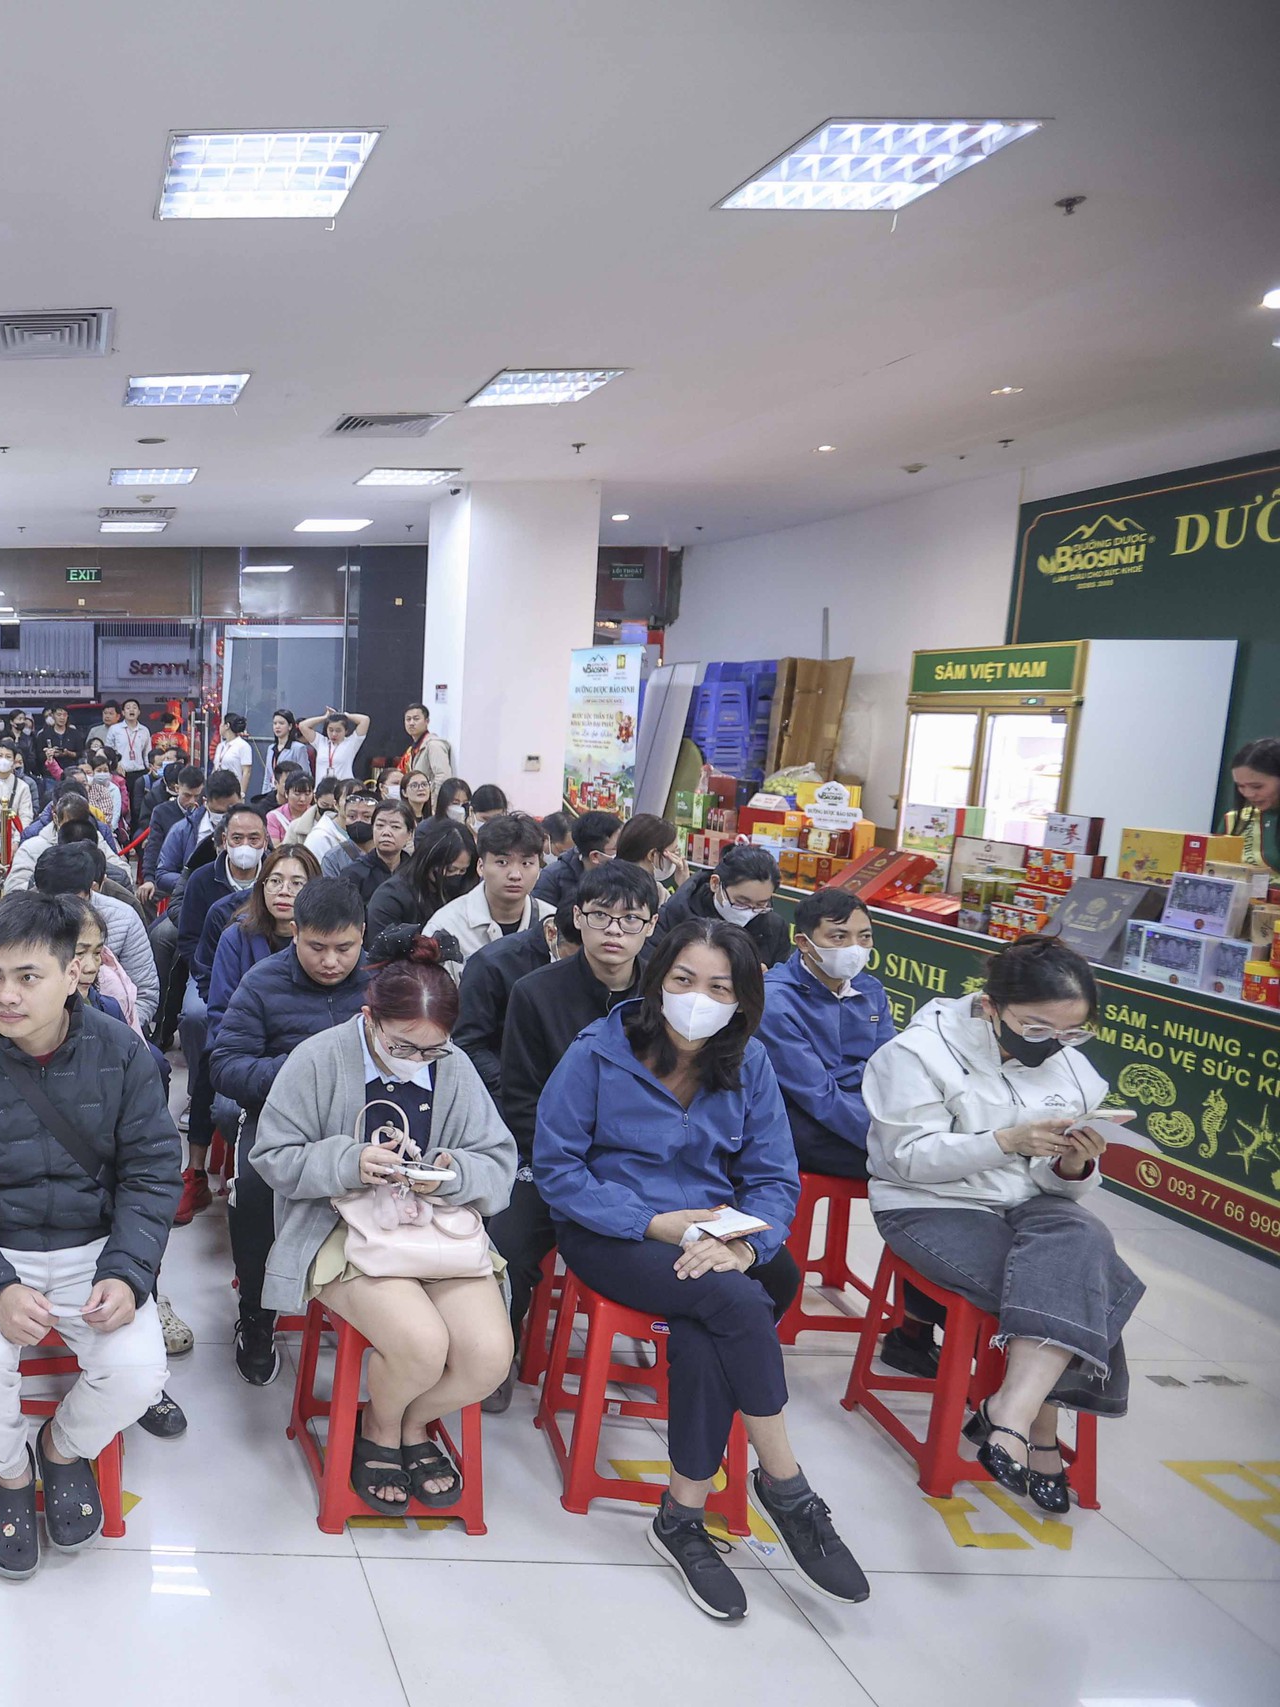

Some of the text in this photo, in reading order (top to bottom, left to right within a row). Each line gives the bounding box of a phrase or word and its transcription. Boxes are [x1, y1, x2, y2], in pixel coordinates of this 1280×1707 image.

[70, 569, 97, 580] EXIT
[935, 660, 1046, 684] SÂM VIỆT NAM
[885, 951, 948, 993] SINH
[1104, 1004, 1148, 1030] SÂM
[1163, 1020, 1242, 1058] NHUNG
[1121, 1033, 1165, 1059] BẢO
[1169, 1047, 1197, 1074] VỆ
[1201, 1058, 1251, 1087] SỨC
[1168, 1176, 1280, 1237] 093 77 66 999
